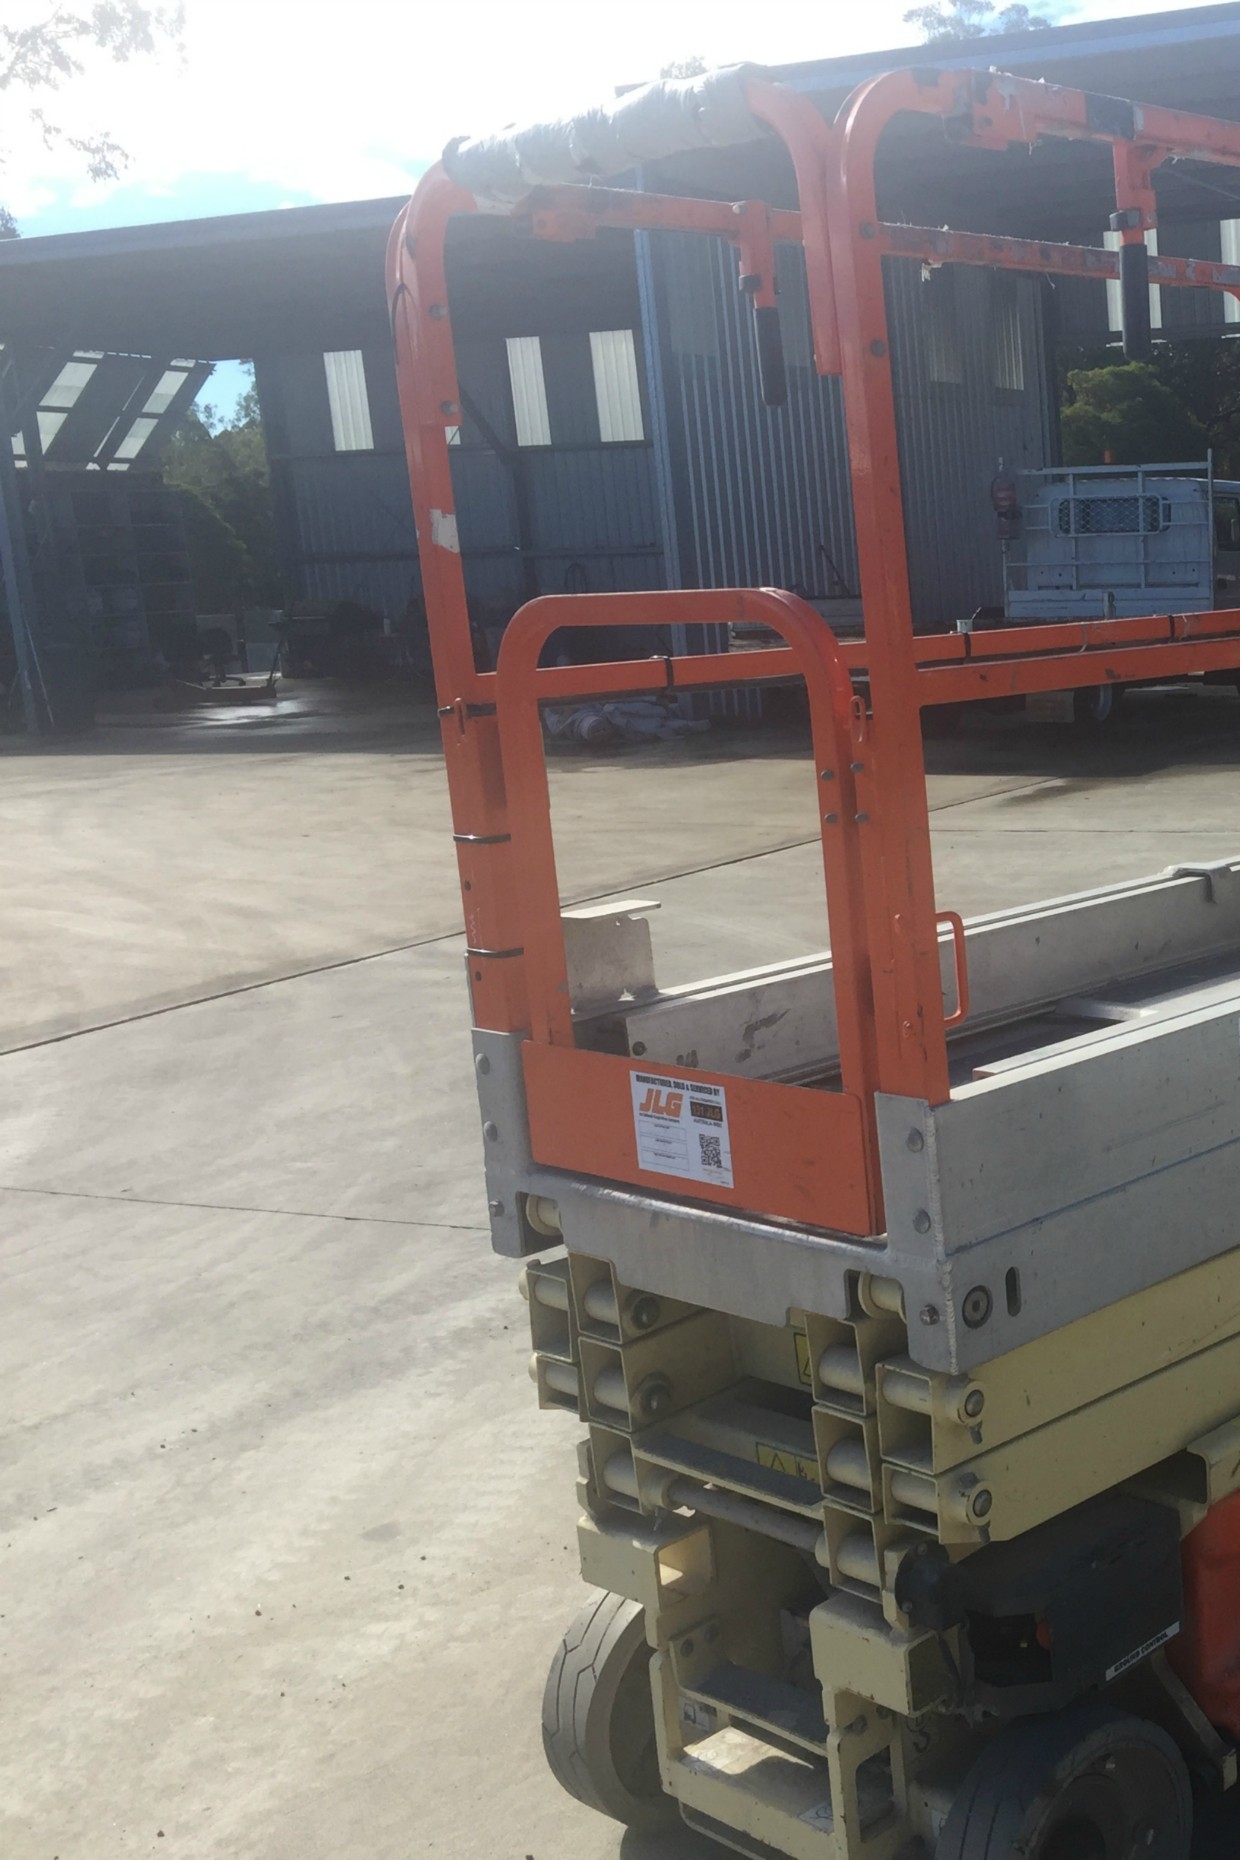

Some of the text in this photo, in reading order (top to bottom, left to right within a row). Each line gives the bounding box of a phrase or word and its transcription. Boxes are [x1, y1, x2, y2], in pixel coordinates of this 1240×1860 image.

[638, 1087, 684, 1118] JLG
[1114, 1631, 1169, 1672] GROUND CONTROL
